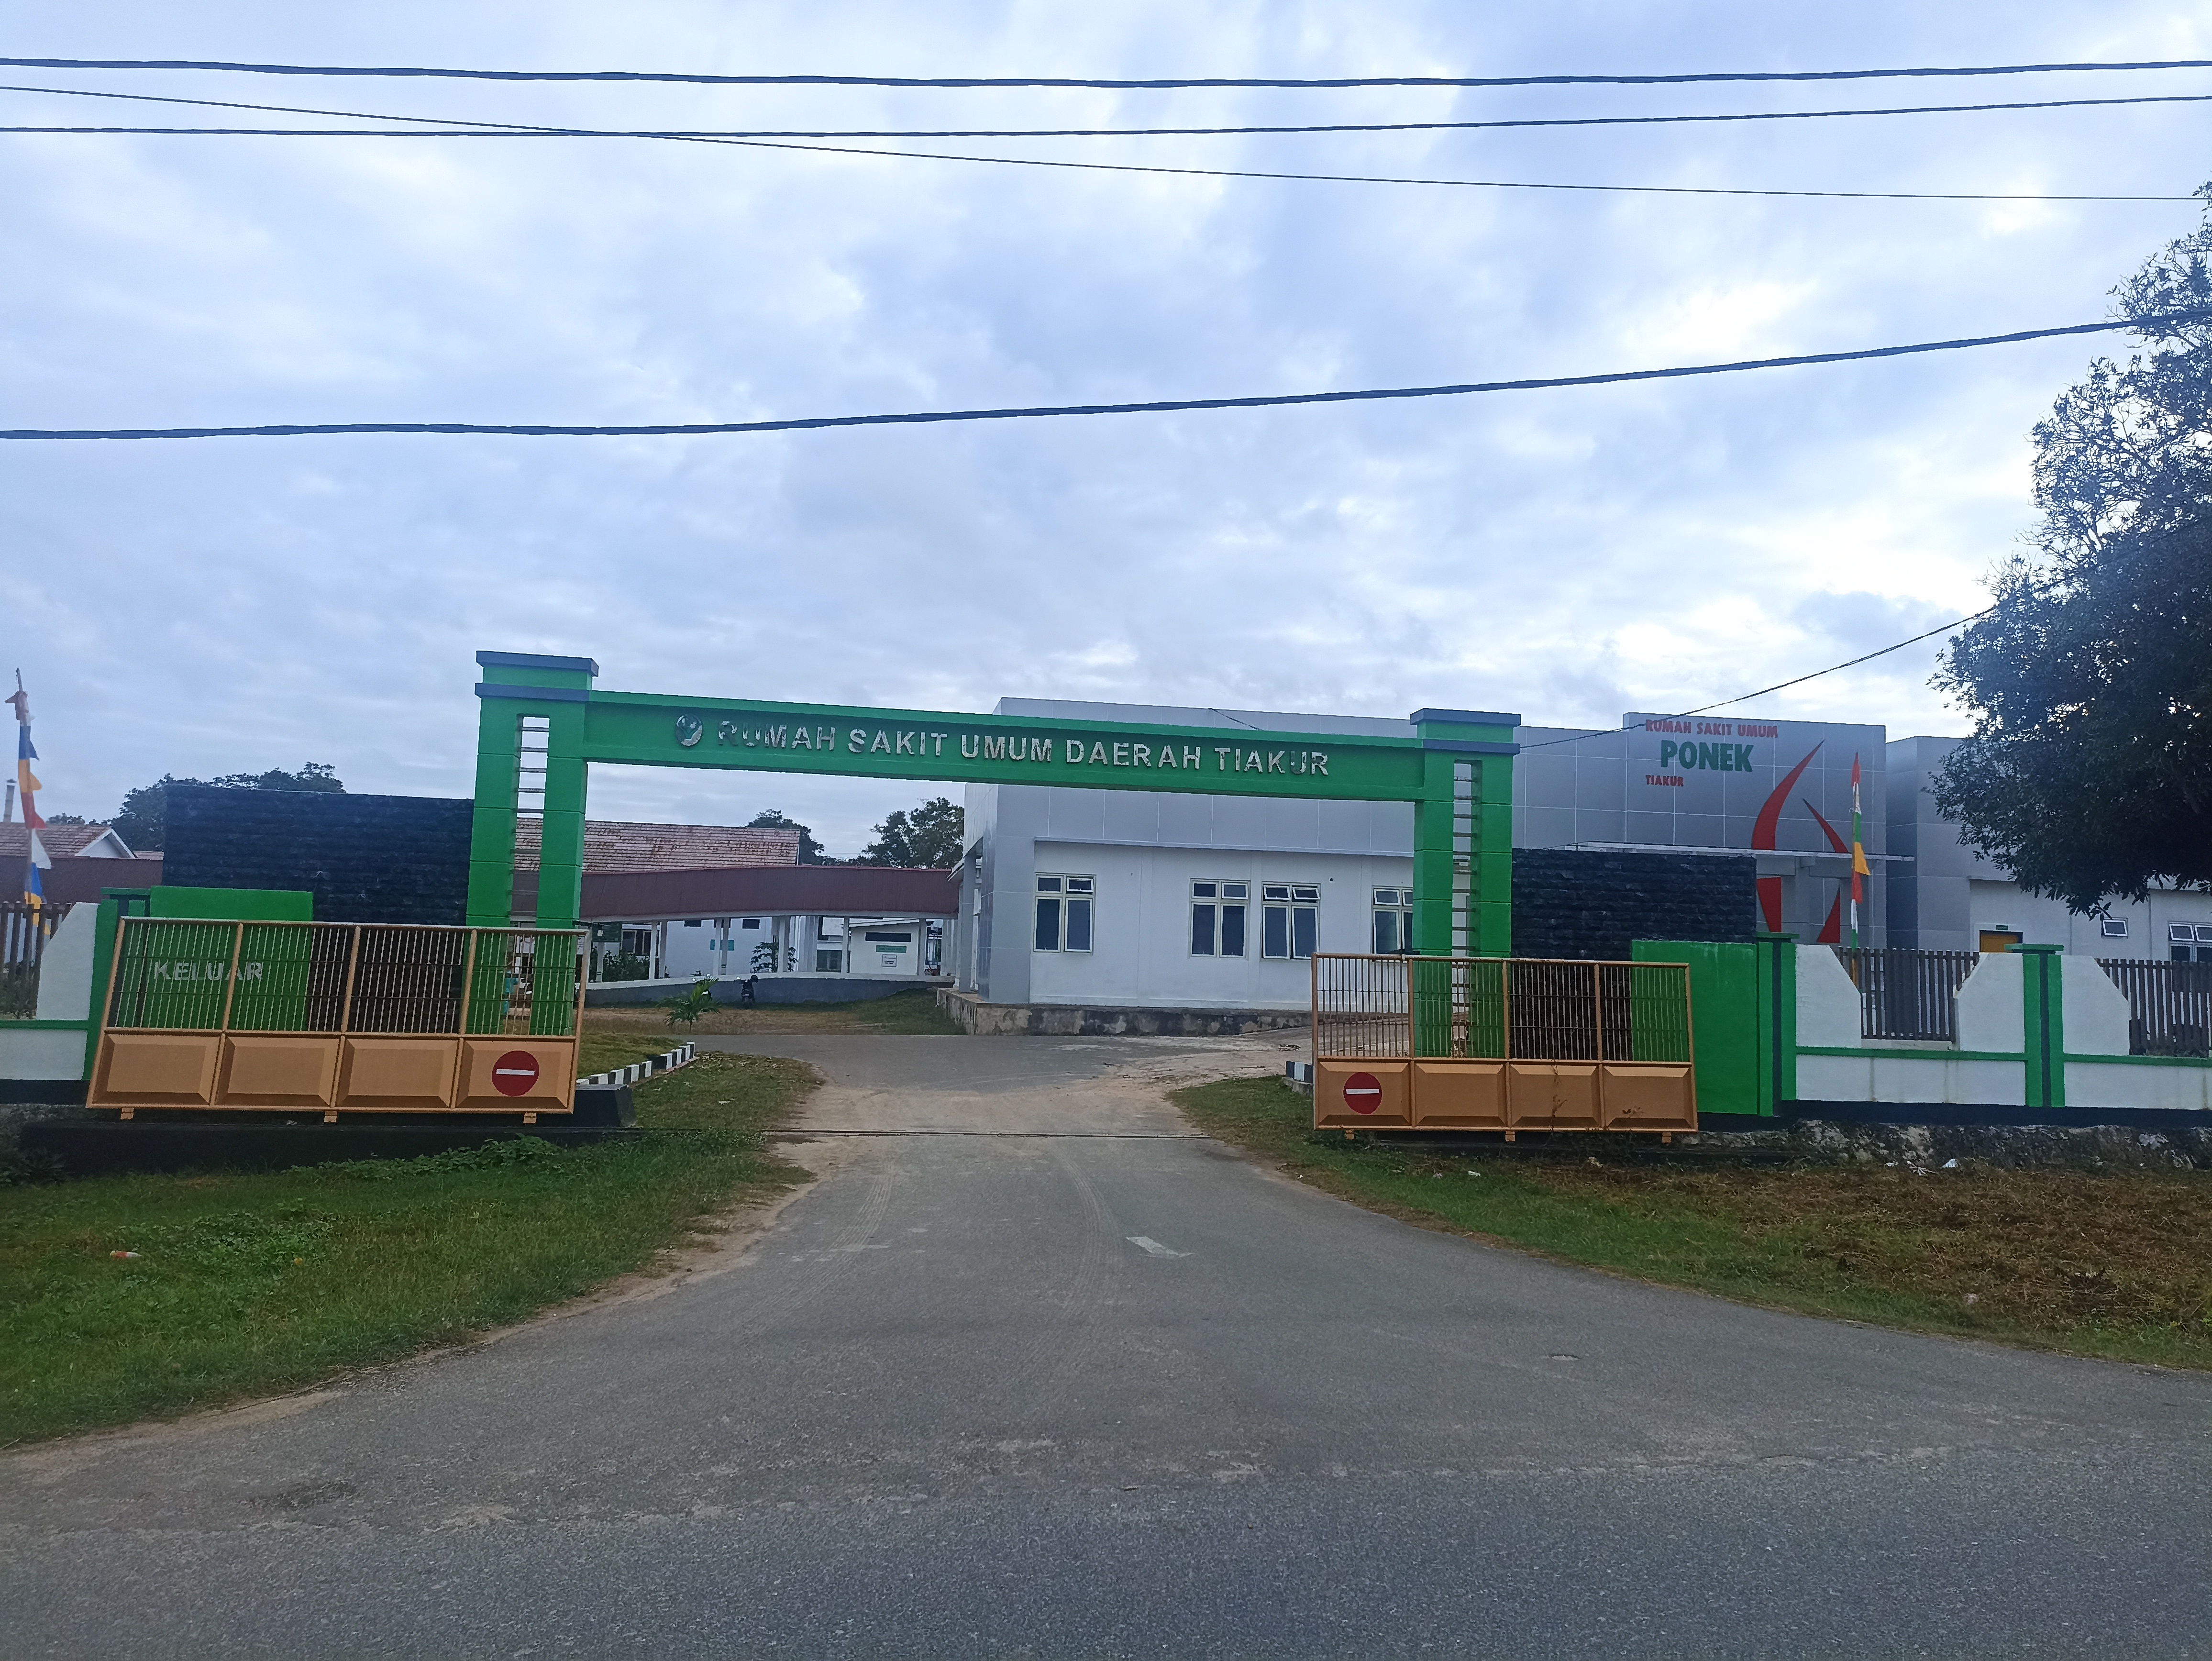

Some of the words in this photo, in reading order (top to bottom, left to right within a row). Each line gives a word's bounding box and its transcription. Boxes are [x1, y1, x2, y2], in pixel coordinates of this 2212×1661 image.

[1646, 720, 1692, 733] RUMAH
[1696, 722, 1733, 736] SAKIT
[1737, 724, 1778, 738] UMUM
[718, 721, 835, 751] RUMAH
[848, 728, 948, 756] SAKIT
[961, 734, 1052, 762] UMUM
[1066, 740, 1200, 769] DAERAH
[1215, 747, 1329, 775] TIAKUR
[1661, 740, 1754, 772] PONEK
[1645, 775, 1684, 786] TIAKUR
[154, 962, 263, 981] KELUAR
